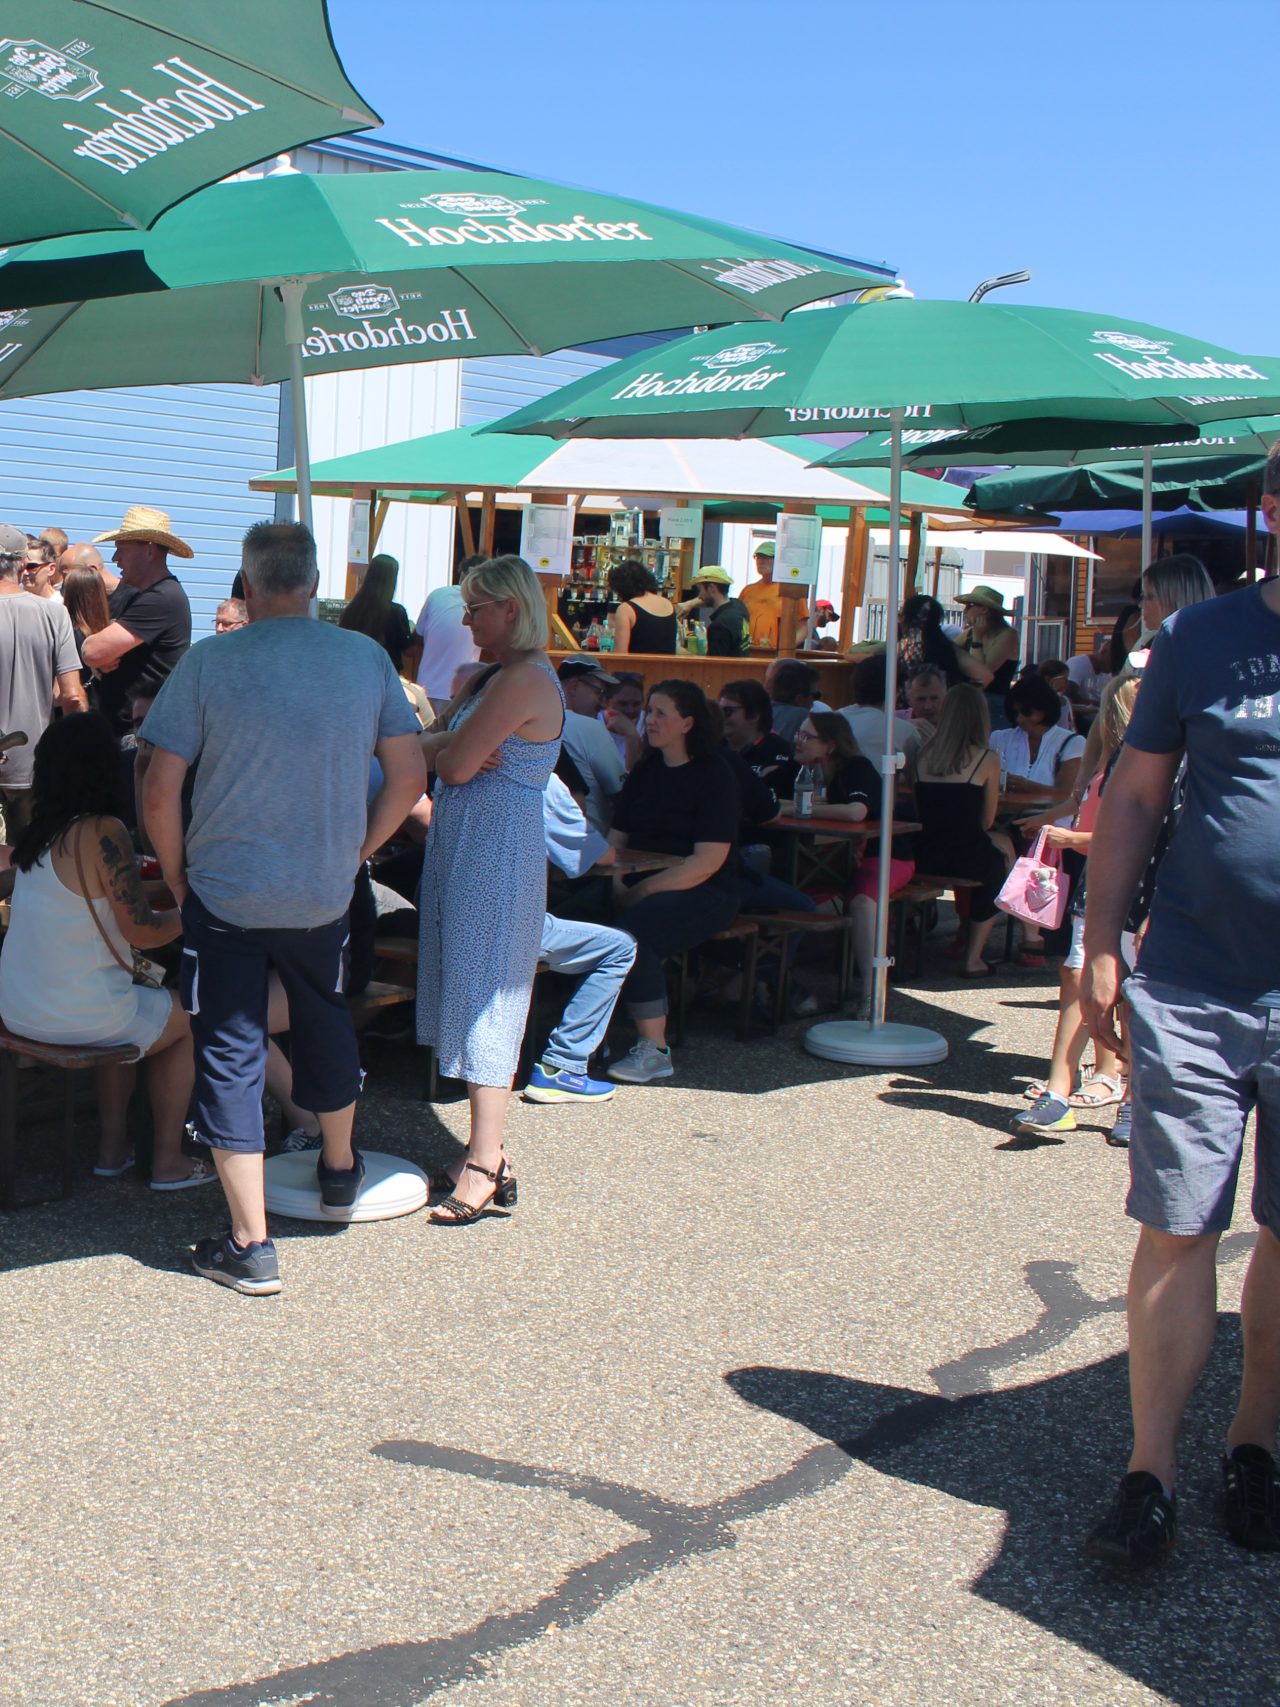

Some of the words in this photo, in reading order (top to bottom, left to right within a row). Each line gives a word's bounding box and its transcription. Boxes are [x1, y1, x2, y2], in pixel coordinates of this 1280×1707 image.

[374, 215, 654, 248] Hochdorfer
[610, 365, 787, 401] Hochdorfer
[1093, 352, 1270, 381] Hochdorfer
